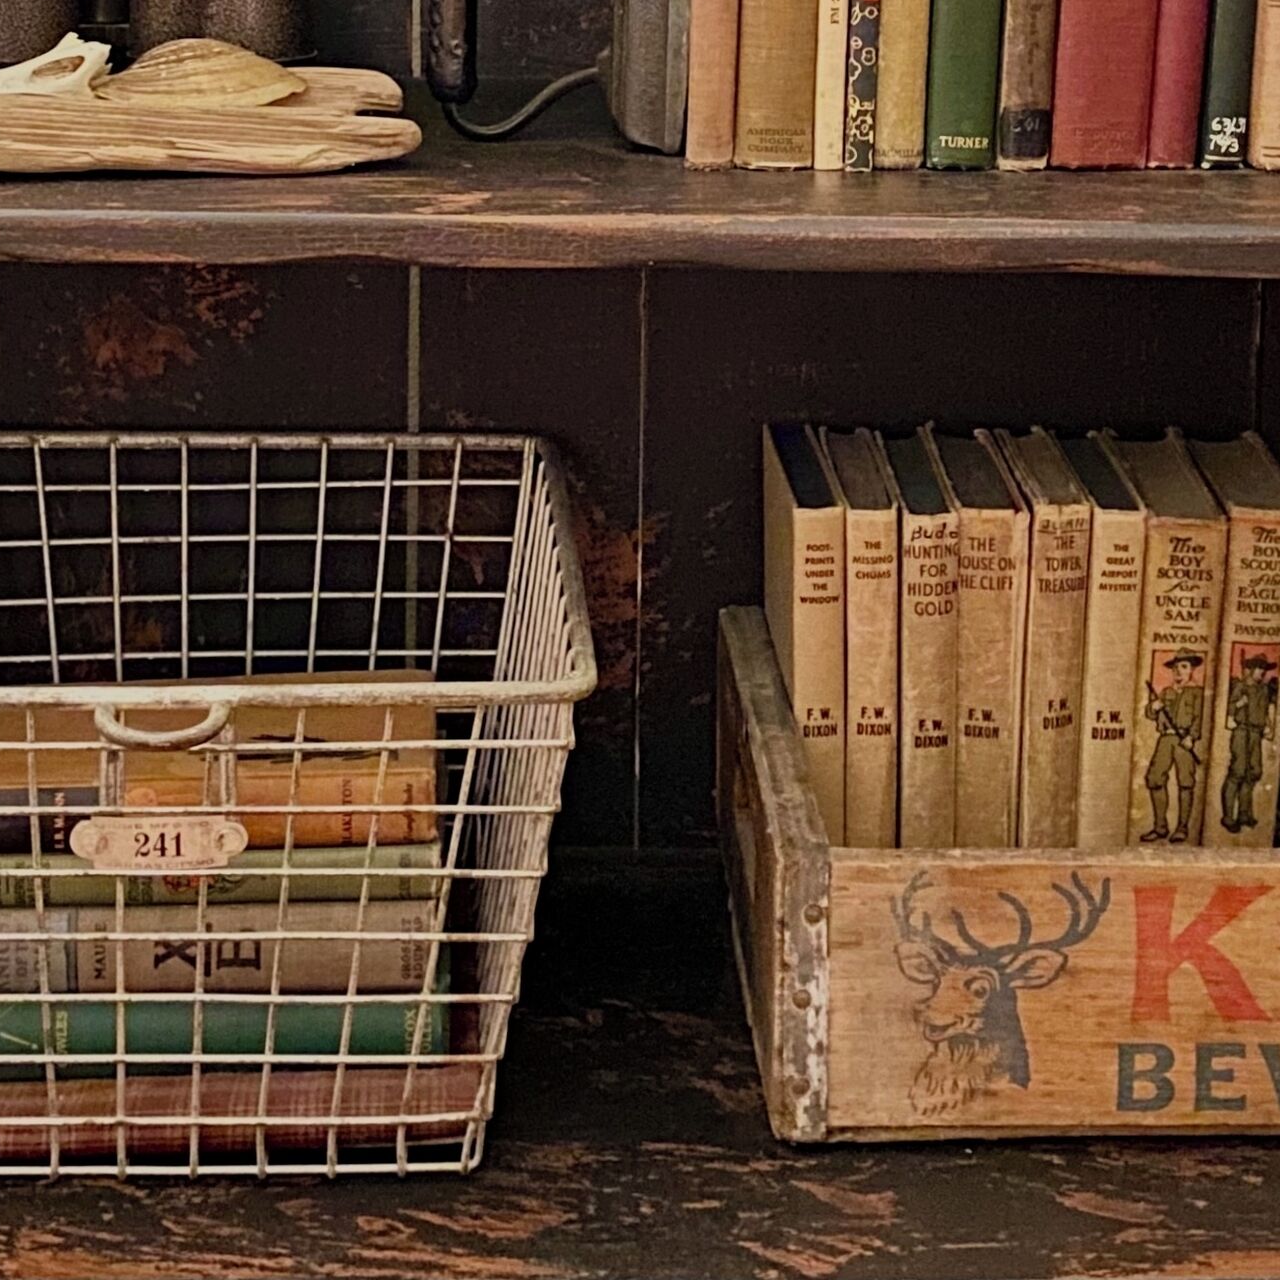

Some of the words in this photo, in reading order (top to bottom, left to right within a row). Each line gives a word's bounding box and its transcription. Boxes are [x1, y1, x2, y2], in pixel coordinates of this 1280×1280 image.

[746, 128, 807, 137] AMERICAN
[939, 135, 990, 149] TURNER
[747, 145, 804, 154] COMPANY
[806, 543, 834, 552] FOOT-
[864, 541, 882, 550] THE
[968, 537, 996, 552] THE
[1055, 536, 1075, 550] THE
[1113, 543, 1129, 553] THE
[1169, 536, 1206, 554] The
[904, 542, 959, 559] HUNTING
[805, 556, 835, 566] PRINTS
[852, 555, 893, 565] MISSING
[998, 557, 1016, 571] ON
[1045, 556, 1081, 572] TOWER
[1106, 556, 1135, 566] GREAT
[1170, 555, 1205, 567] BOY
[805, 569, 835, 578] UNDER
[855, 570, 891, 580] CHUMS
[920, 563, 948, 578] FOR
[1101, 569, 1138, 579] AIRPORT
[1157, 568, 1214, 582] SCOUTS
[812, 582, 828, 591] THE
[907, 581, 958, 597] HIDDEN
[1099, 582, 1137, 592] MYSTERY
[1164, 580, 1200, 594] for
[800, 595, 841, 604] WINDOW
[1155, 596, 1211, 610] UNCLE
[914, 601, 953, 617] GOLD
[1164, 609, 1201, 622] SAM
[1152, 632, 1209, 645] PAYSON
[1048, 699, 1058, 712] F.
[1059, 699, 1071, 711] W.
[806, 708, 818, 720] F.
[820, 708, 833, 720] W.
[860, 707, 872, 719] F.
[873, 707, 888, 720] W.
[968, 709, 979, 722] F.
[981, 709, 996, 722] W.
[1096, 710, 1107, 723] F.
[1108, 710, 1123, 724] W.
[856, 721, 892, 736] DIXON
[918, 720, 929, 733] F.
[931, 720, 945, 733] W.
[1043, 714, 1073, 730] DIXON
[803, 723, 838, 738] DIXON
[964, 723, 1000, 739] DIXON
[1091, 725, 1126, 740] DIXON
[914, 734, 949, 748] DIXON
[133, 832, 185, 859] 241
